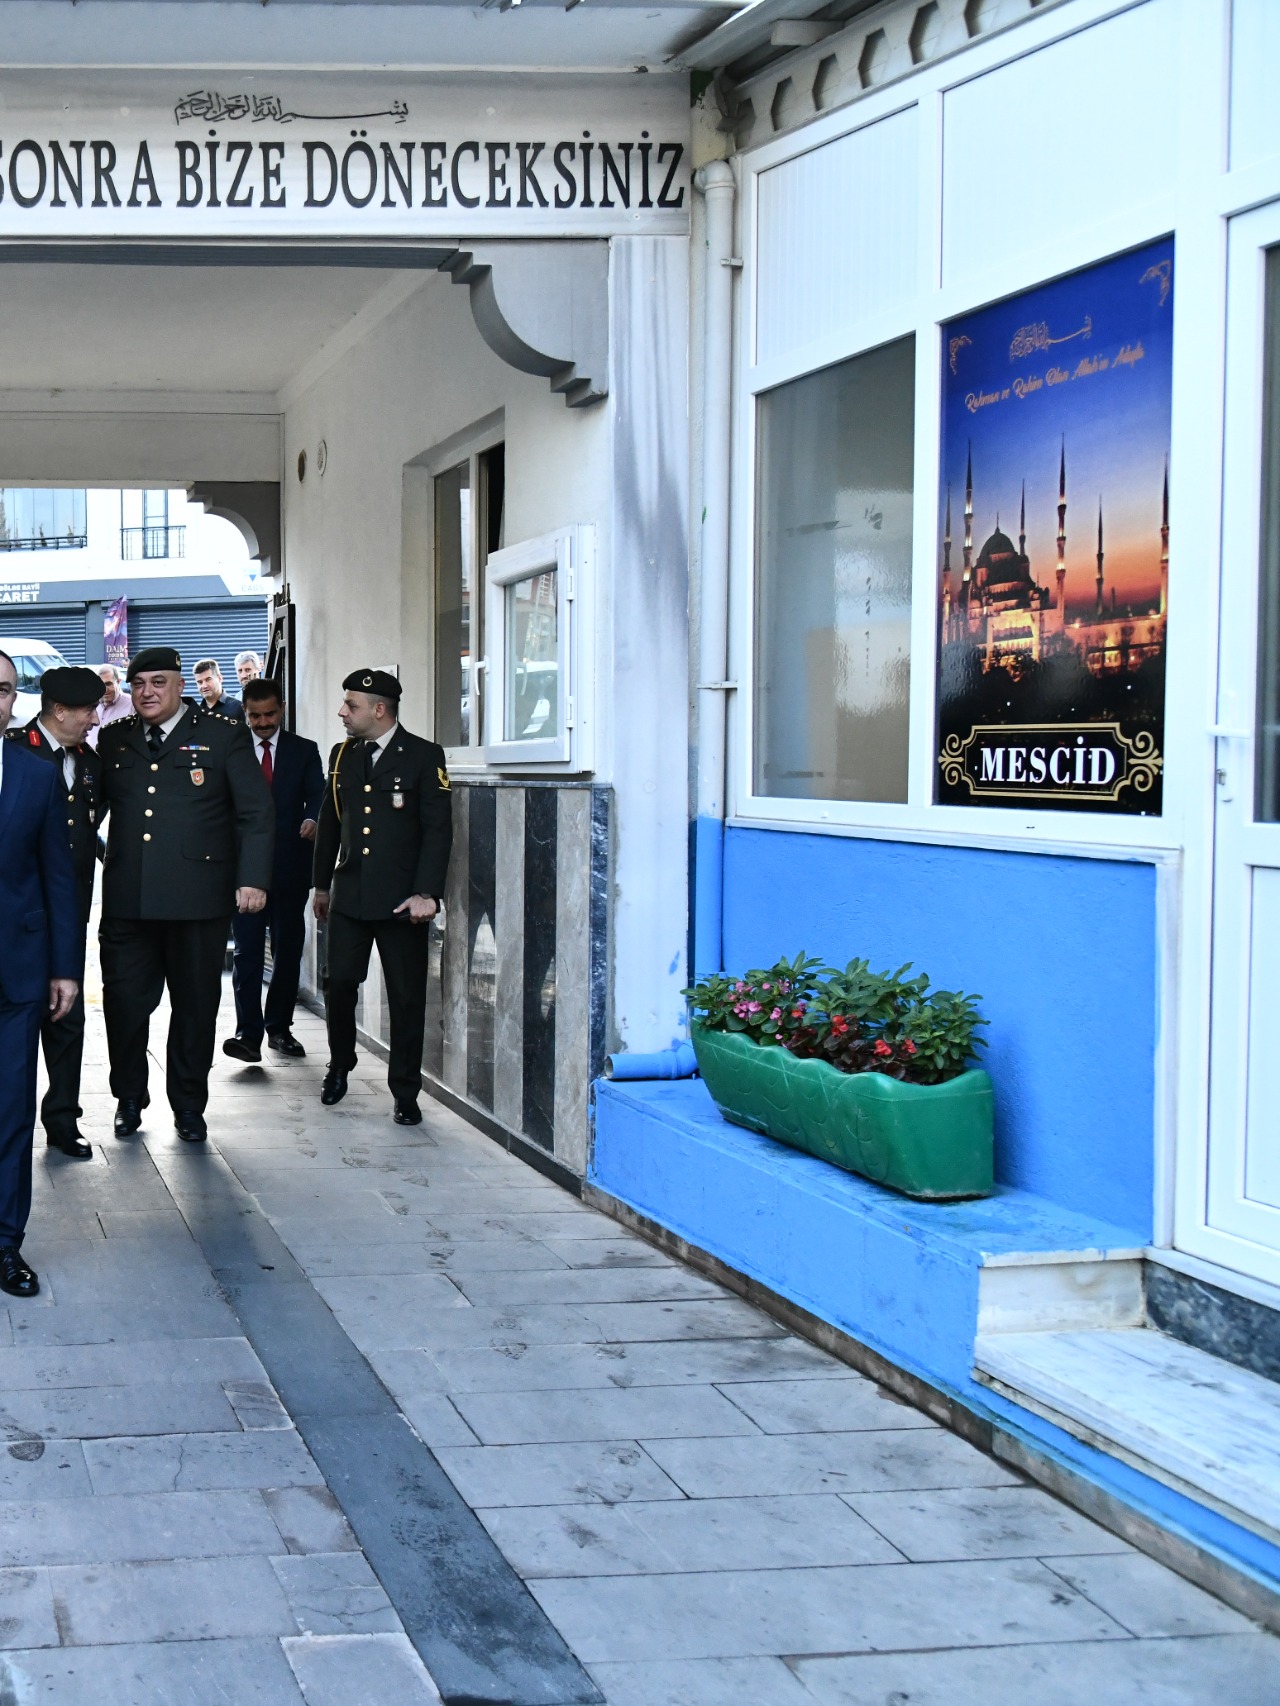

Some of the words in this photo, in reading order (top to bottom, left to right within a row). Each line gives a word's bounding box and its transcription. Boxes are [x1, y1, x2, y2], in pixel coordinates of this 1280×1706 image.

[175, 129, 287, 209] BİZE
[302, 129, 686, 209] DÖNECEKSİNİZ
[979, 735, 1116, 785] MESCİD
